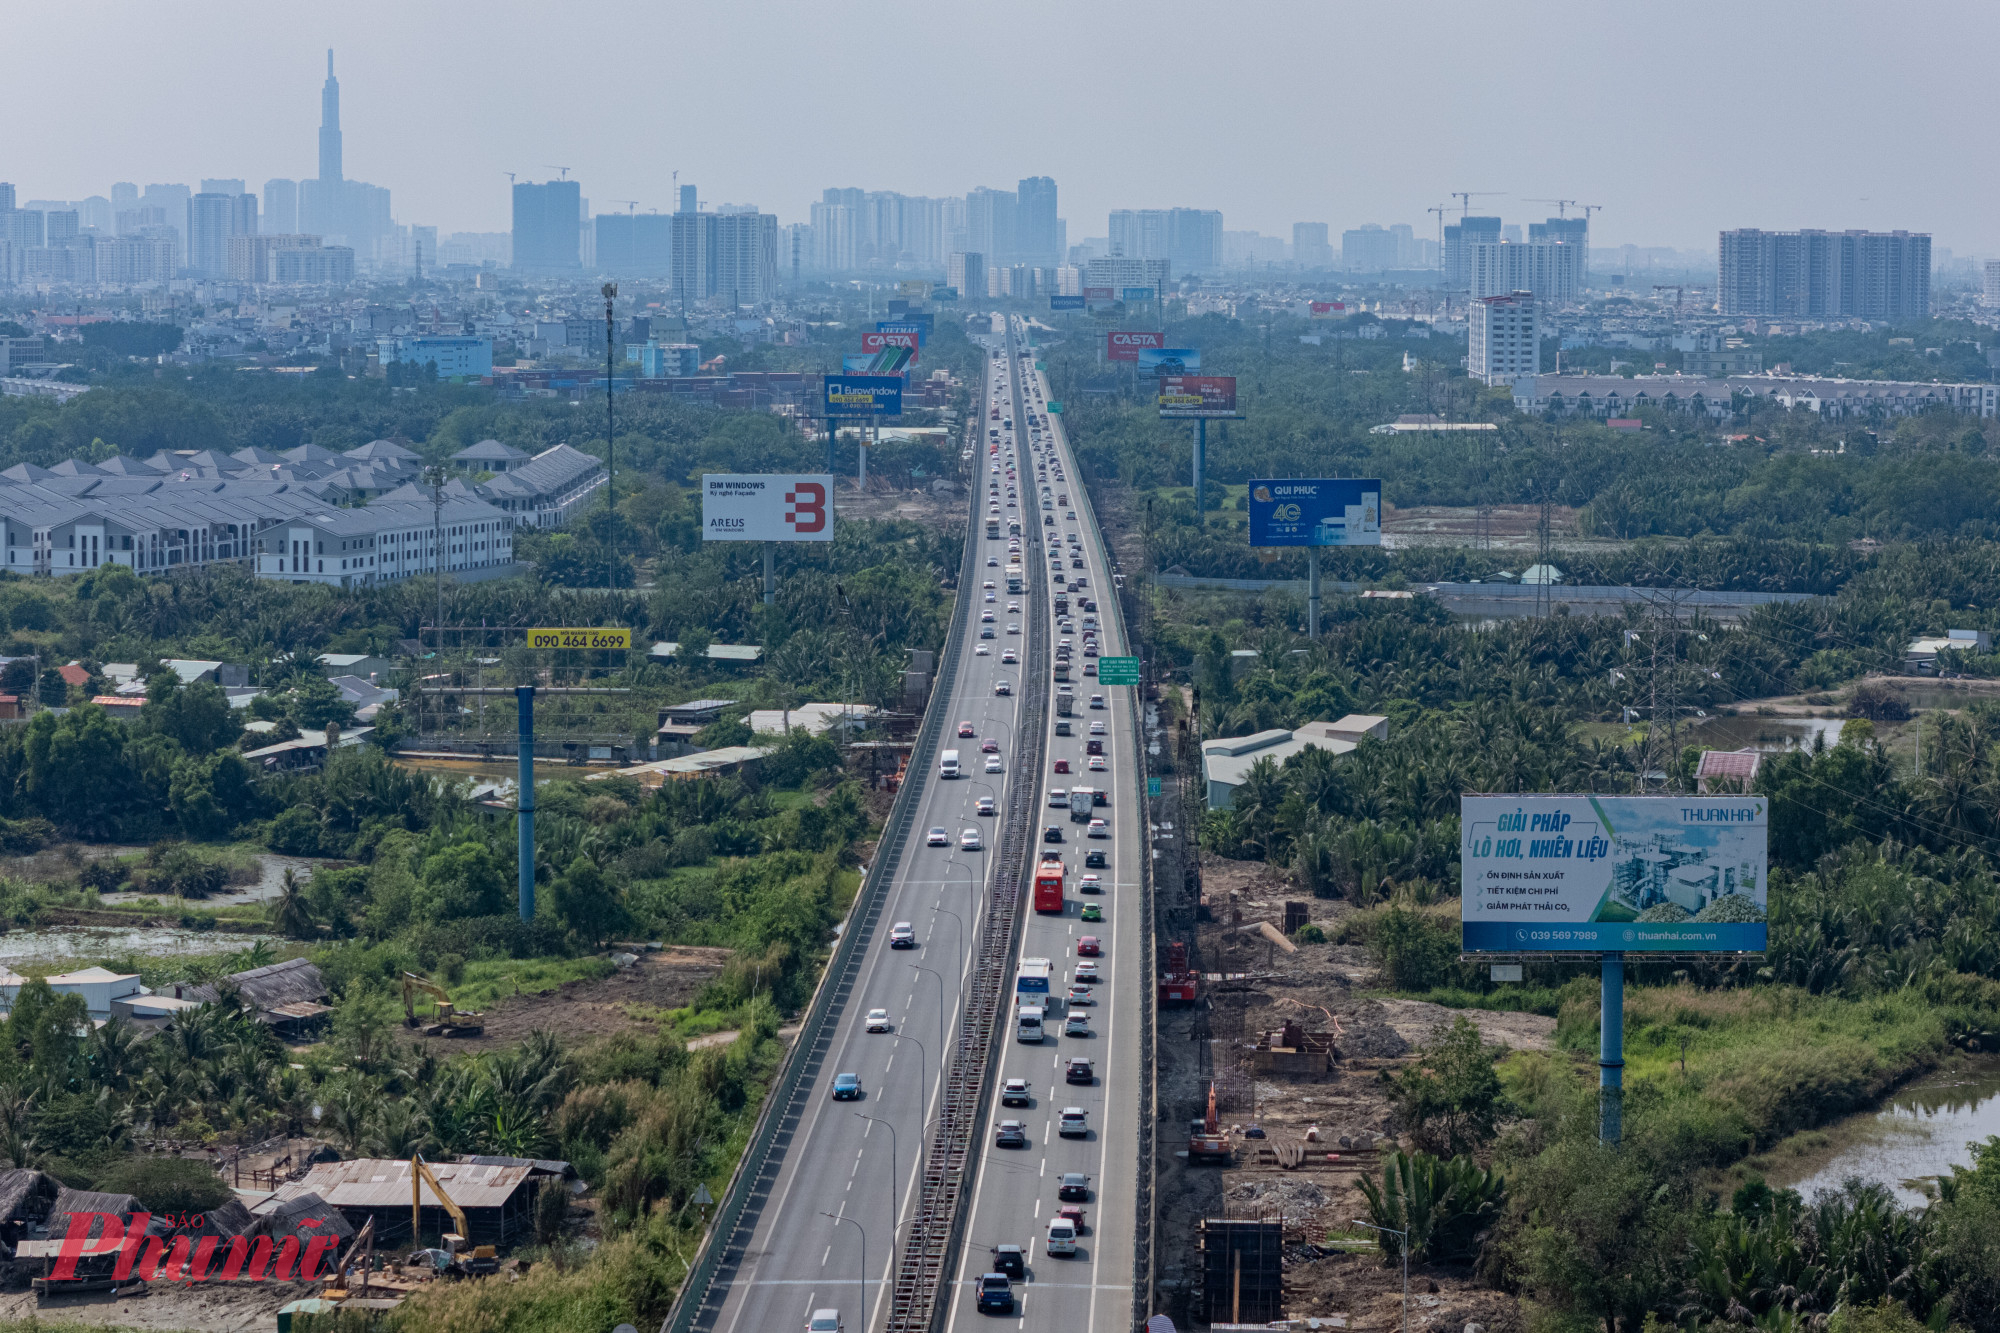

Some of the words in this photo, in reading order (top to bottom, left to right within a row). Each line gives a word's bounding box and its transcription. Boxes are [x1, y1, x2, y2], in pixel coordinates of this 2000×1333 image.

[867, 335, 912, 345] CASTA
[1113, 334, 1157, 345] CASTA
[844, 386, 898, 396] Eurowindow
[710, 481, 724, 489] BM
[725, 481, 766, 490] WINDOWS
[1274, 486, 1292, 495] QUI
[1293, 486, 1317, 495] PHUC
[710, 518, 745, 527] AREUS
[534, 635, 559, 647] 090
[563, 635, 588, 647] 464
[592, 635, 625, 647] 6699
[1497, 808, 1527, 832] GIẢI
[1530, 809, 1571, 832] PHÁP
[1472, 835, 1492, 858] LÒ
[1495, 838, 1524, 860] HƠI,
[1528, 835, 1574, 858] NHIÊN
[1576, 836, 1609, 862] LIỆU
[1501, 872, 1522, 880] ĐỊNH
[1523, 870, 1541, 879] SẢN
[1543, 870, 1565, 880] XUẤT
[1487, 886, 1504, 895] TIẾT
[1506, 886, 1526, 896] KIỆM
[1545, 886, 1559, 895] PHÍ
[1486, 901, 1509, 910] GIẢM
[1510, 902, 1532, 910] PHÁT
[1534, 902, 1553, 910] THẢI
[1531, 931, 1549, 940] 039
[1551, 931, 1571, 940] 569
[1573, 931, 1598, 940] 7989
[1638, 931, 1717, 940] thuanhai.com.vn
